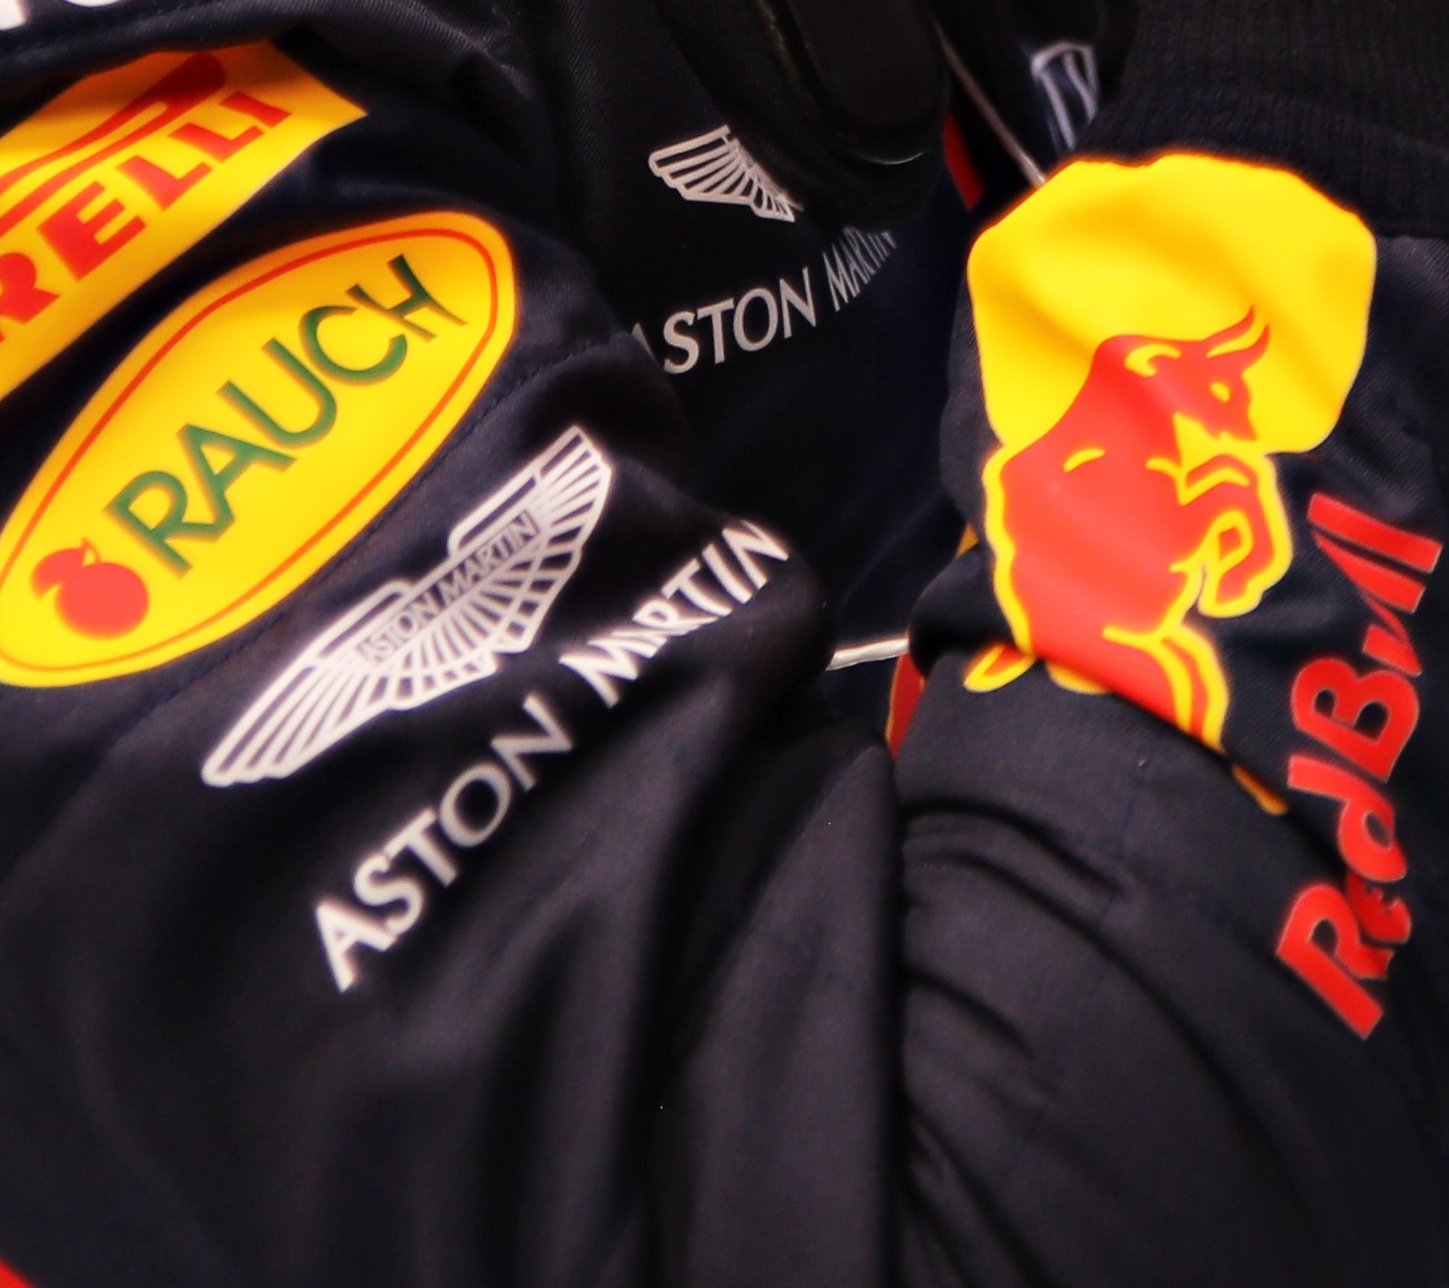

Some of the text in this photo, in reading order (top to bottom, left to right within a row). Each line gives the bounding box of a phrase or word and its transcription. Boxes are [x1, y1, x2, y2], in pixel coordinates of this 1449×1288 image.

[103, 254, 468, 575] RAUCH
[315, 519, 790, 993] ASTON MARTIN
